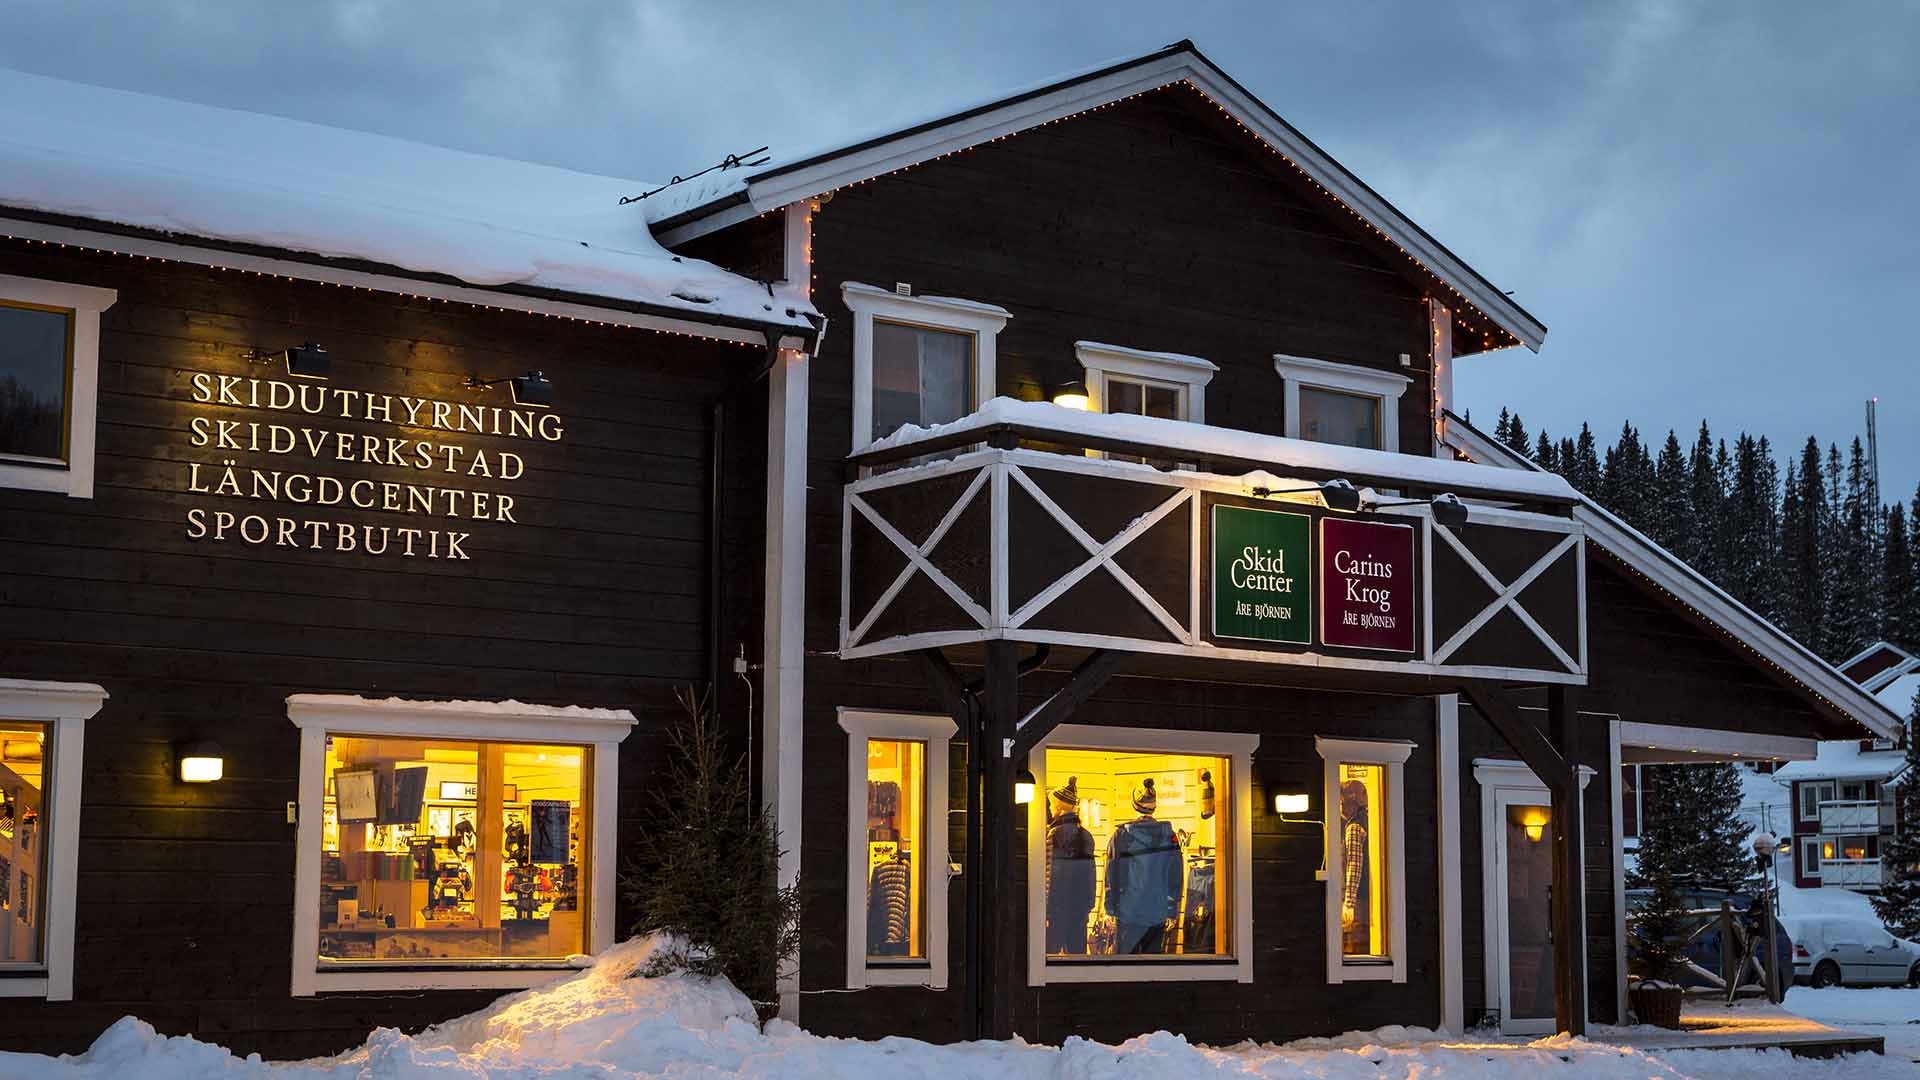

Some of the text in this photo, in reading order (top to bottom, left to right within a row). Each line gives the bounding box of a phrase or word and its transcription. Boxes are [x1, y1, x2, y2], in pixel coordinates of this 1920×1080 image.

[192, 373, 564, 441] SKIDUTHYRNING
[190, 417, 524, 480] SKIDVERKSTAD
[188, 459, 517, 523] LÄNGDCENTER
[186, 509, 470, 560] SPORTBUTIK
[1231, 558, 1294, 593] Center
[1243, 546, 1285, 574] Skid
[1335, 550, 1393, 579] Carins
[1235, 600, 1292, 620] ÅRE BJÖRNEN
[1345, 578, 1391, 613] Krog
[1343, 610, 1396, 629] ÅRE BJÖRNEN
